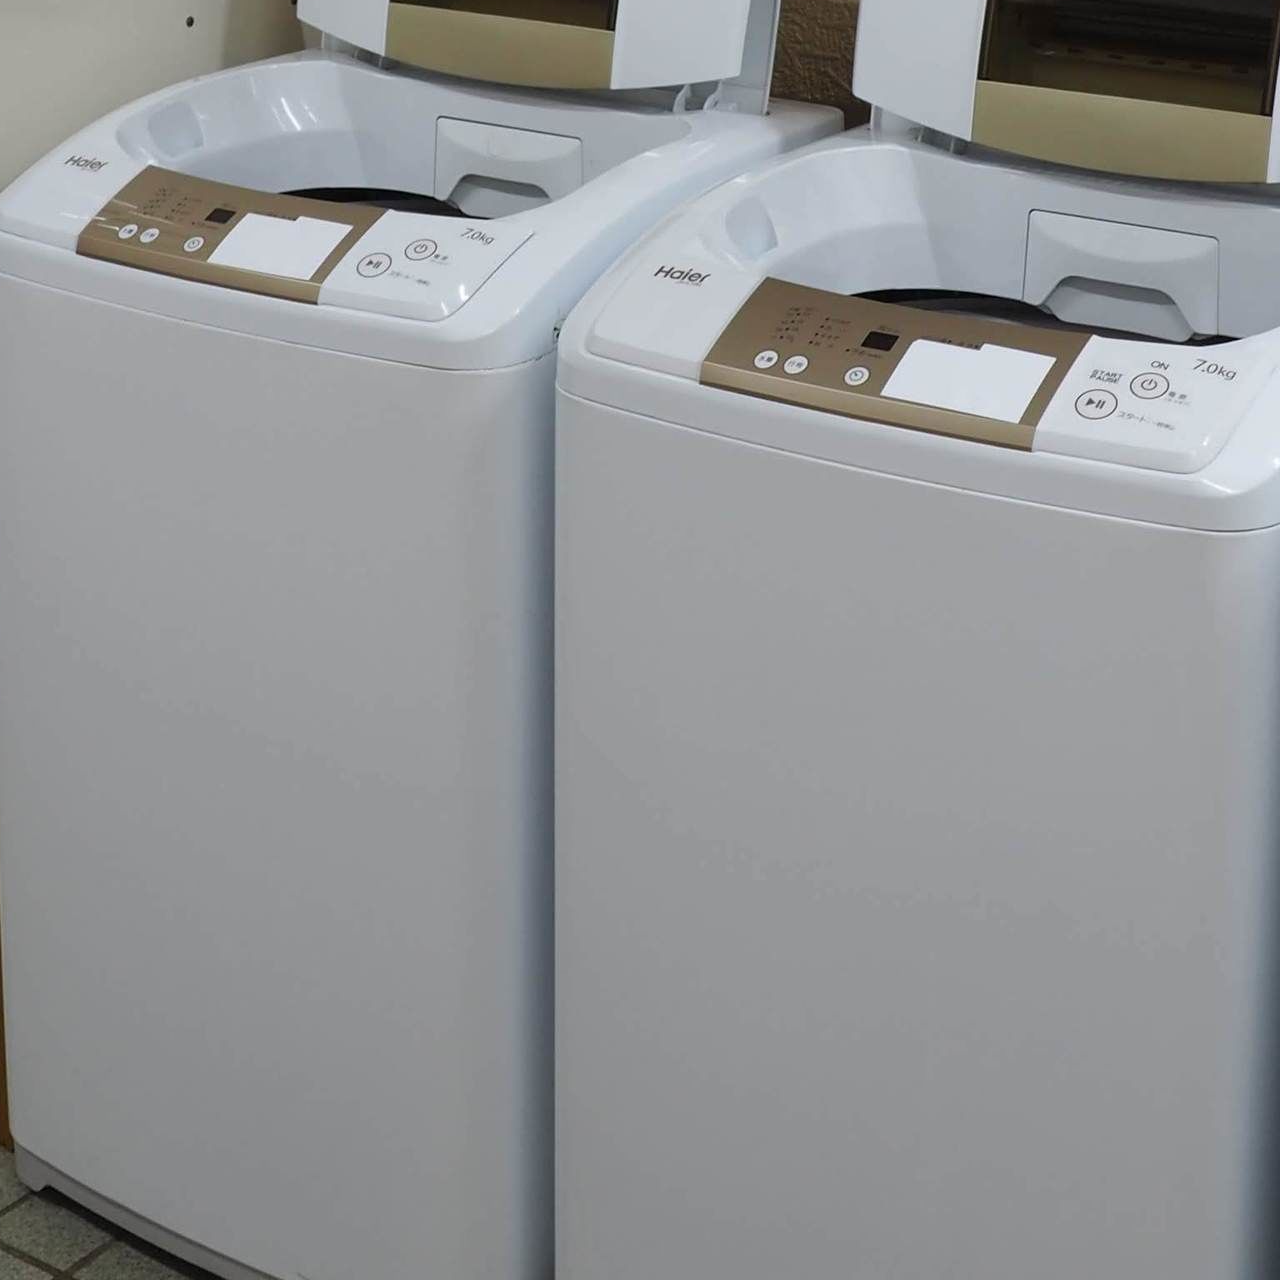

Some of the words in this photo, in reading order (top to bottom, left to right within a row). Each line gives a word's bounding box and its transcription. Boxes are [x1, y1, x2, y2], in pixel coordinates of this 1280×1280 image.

[64, 153, 109, 172] Haier
[460, 227, 495, 246] 7.0kg
[653, 264, 712, 286] Haier
[1150, 360, 1170, 371] ON
[1192, 358, 1238, 381] 7.0kg
